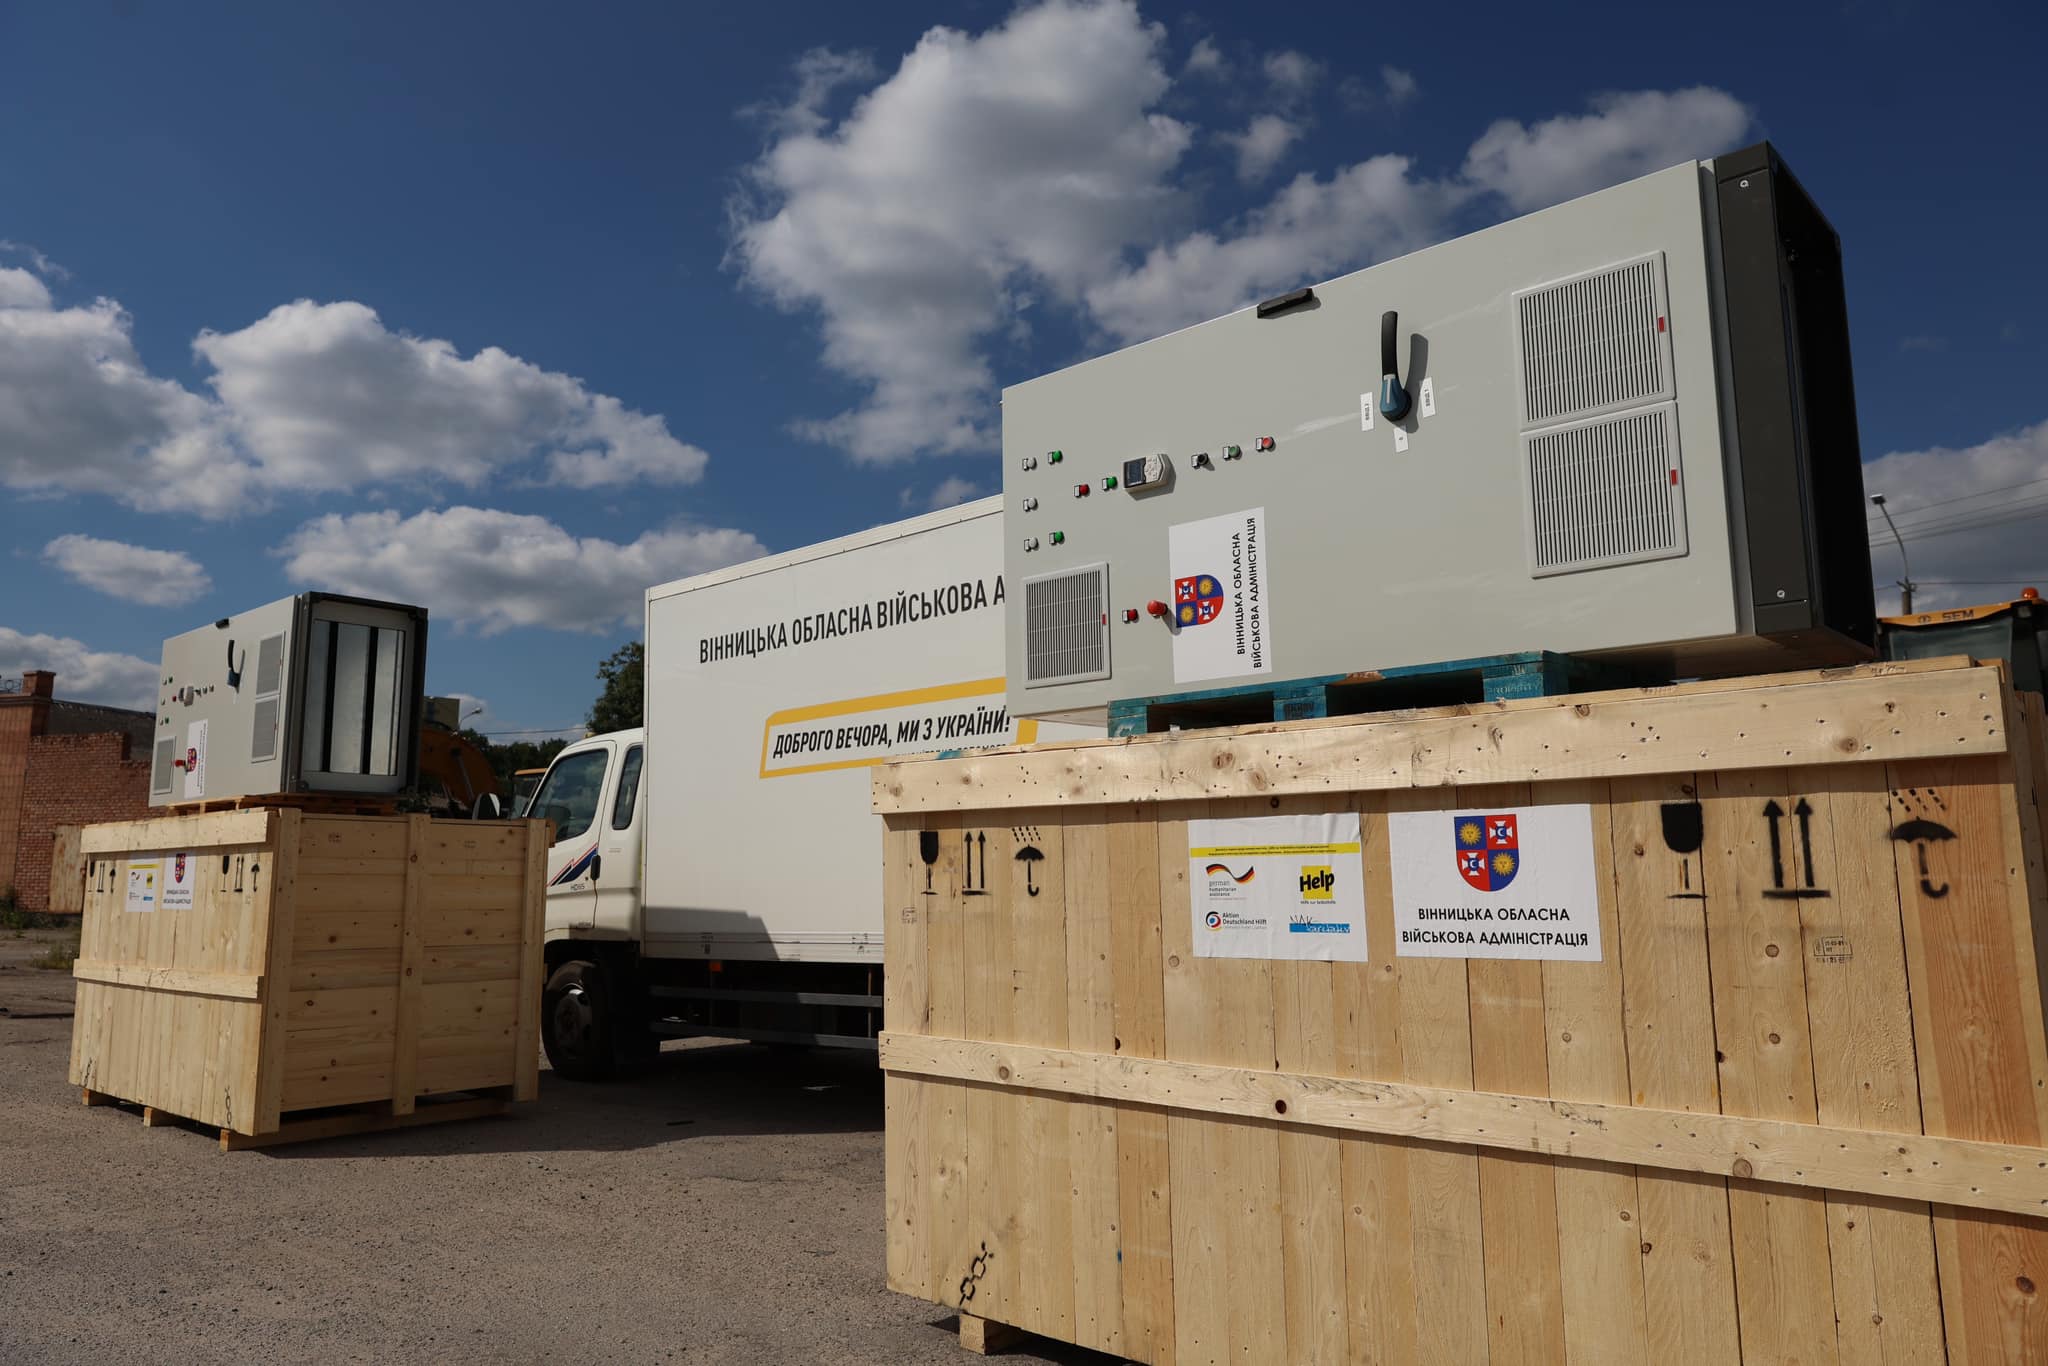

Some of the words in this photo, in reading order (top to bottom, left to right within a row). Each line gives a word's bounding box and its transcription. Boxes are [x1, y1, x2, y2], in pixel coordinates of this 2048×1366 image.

[1232, 532, 1243, 589] ОБЛАСНА
[1247, 517, 1259, 602] АДМІНІСТРАЦІЯ
[699, 621, 788, 664] ВІННИЦЬКА
[792, 603, 873, 645] ОБЛАСНА
[876, 579, 988, 629] ВІЙСЬКОВА
[1234, 591, 1246, 655] ВІННИЦЬКА
[1250, 605, 1262, 669] ВІЙСЬКОВА
[1942, 609, 1975, 621] SEM
[773, 729, 834, 759] ДОБРОГО
[835, 723, 892, 749] ВЕЧОРА,
[896, 719, 919, 744] МИ
[935, 706, 1010, 739] УКРАЇНИ!
[1299, 869, 1335, 892] Help
[1402, 928, 1475, 944] ВІЙСЬКОВА
[1479, 931, 1589, 947] АДМІНІСТРАЦІЯ
[1418, 908, 1494, 922] ВІННИЦЬКА
[1497, 908, 1571, 921] ОБЛАСНА
